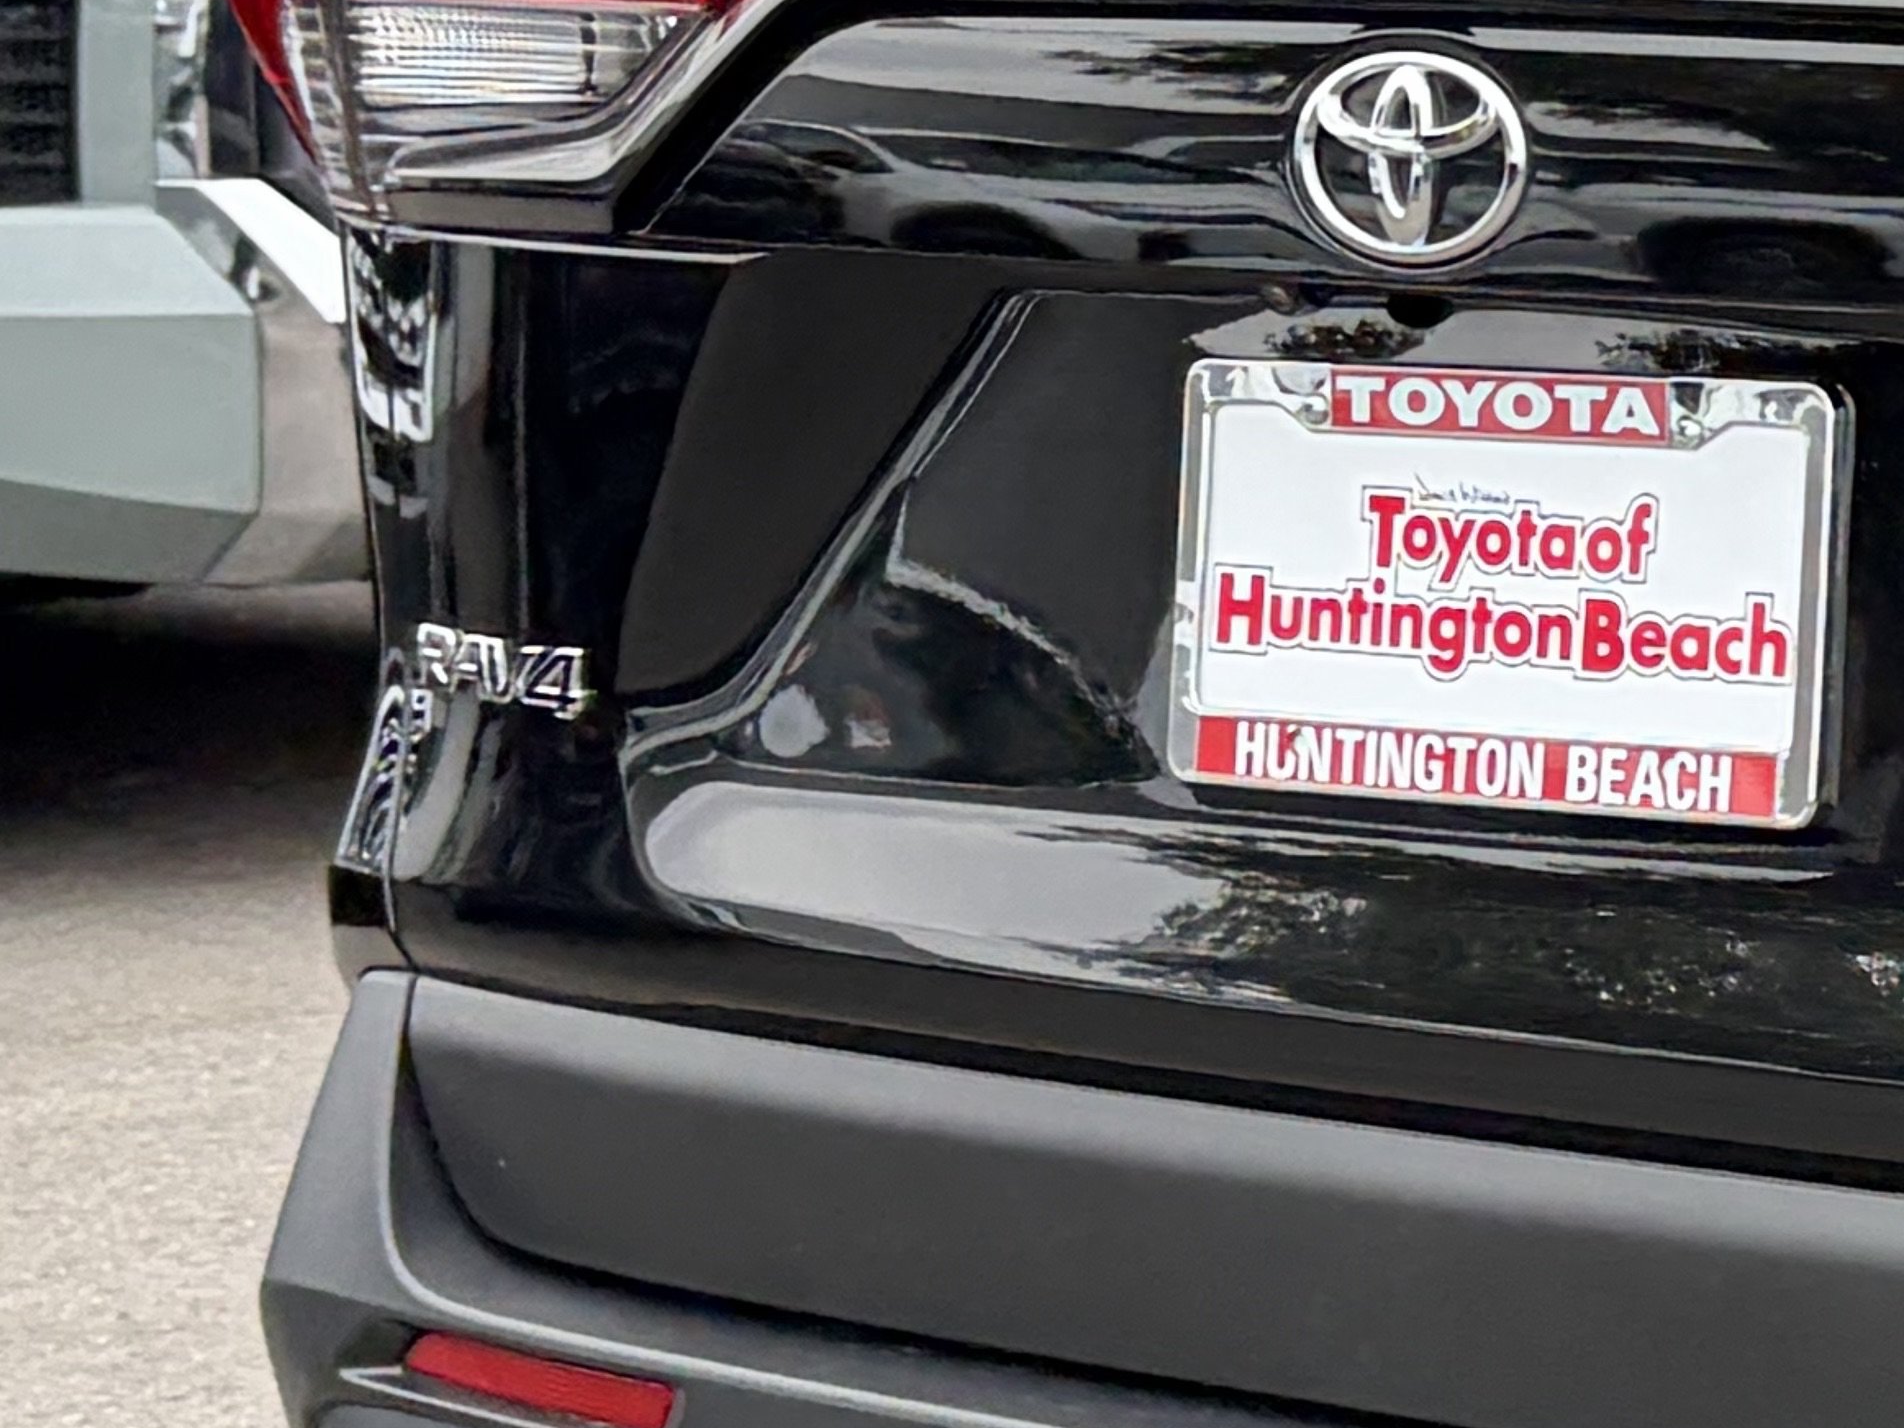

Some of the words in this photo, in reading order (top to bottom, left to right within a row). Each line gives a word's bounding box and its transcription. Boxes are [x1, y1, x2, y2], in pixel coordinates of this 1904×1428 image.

[1339, 375, 1660, 436] TOYOTA
[1368, 494, 1580, 584] Toyota
[416, 622, 598, 721] RAV4
[1215, 572, 1574, 674] Huntington
[1581, 598, 1788, 678] Beach
[1235, 720, 1545, 802] HUNTINGTON
[1565, 749, 1732, 813] BEACH
